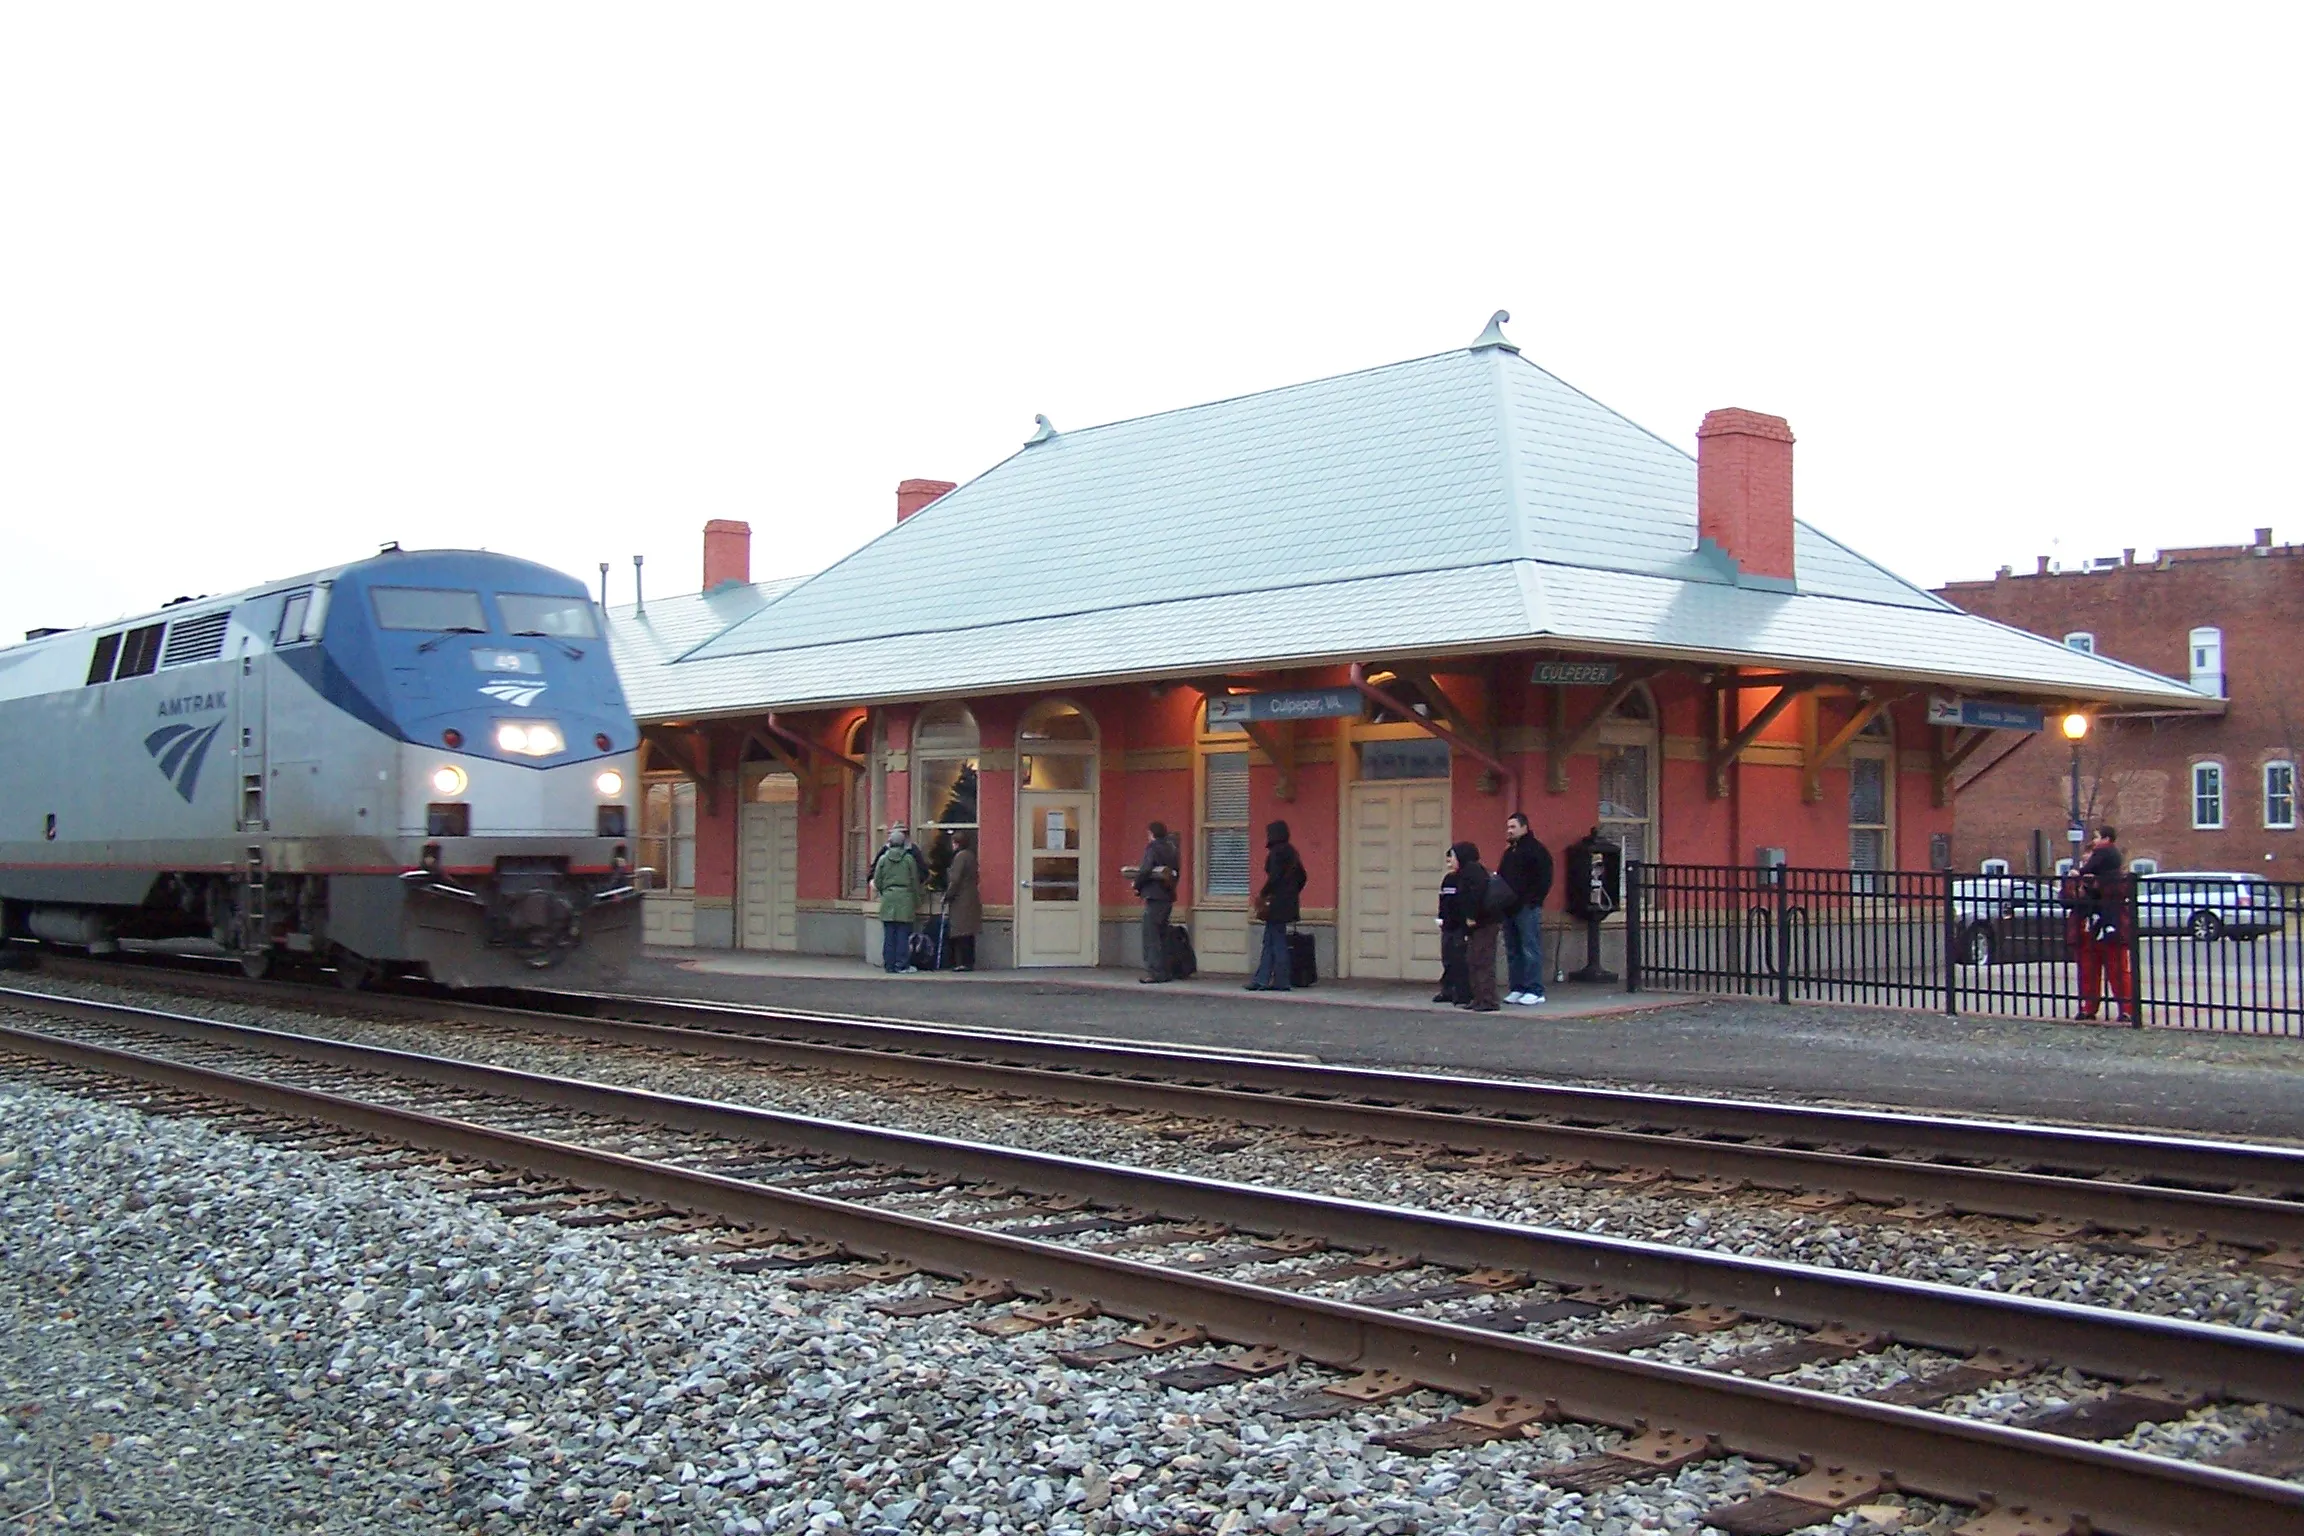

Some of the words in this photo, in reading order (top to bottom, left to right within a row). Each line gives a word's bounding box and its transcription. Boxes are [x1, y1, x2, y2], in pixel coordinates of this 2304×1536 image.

[1541, 665, 1608, 681] CULPEPER
[158, 691, 227, 717] AMTRAK
[1270, 698, 1323, 714] Culpeper,
